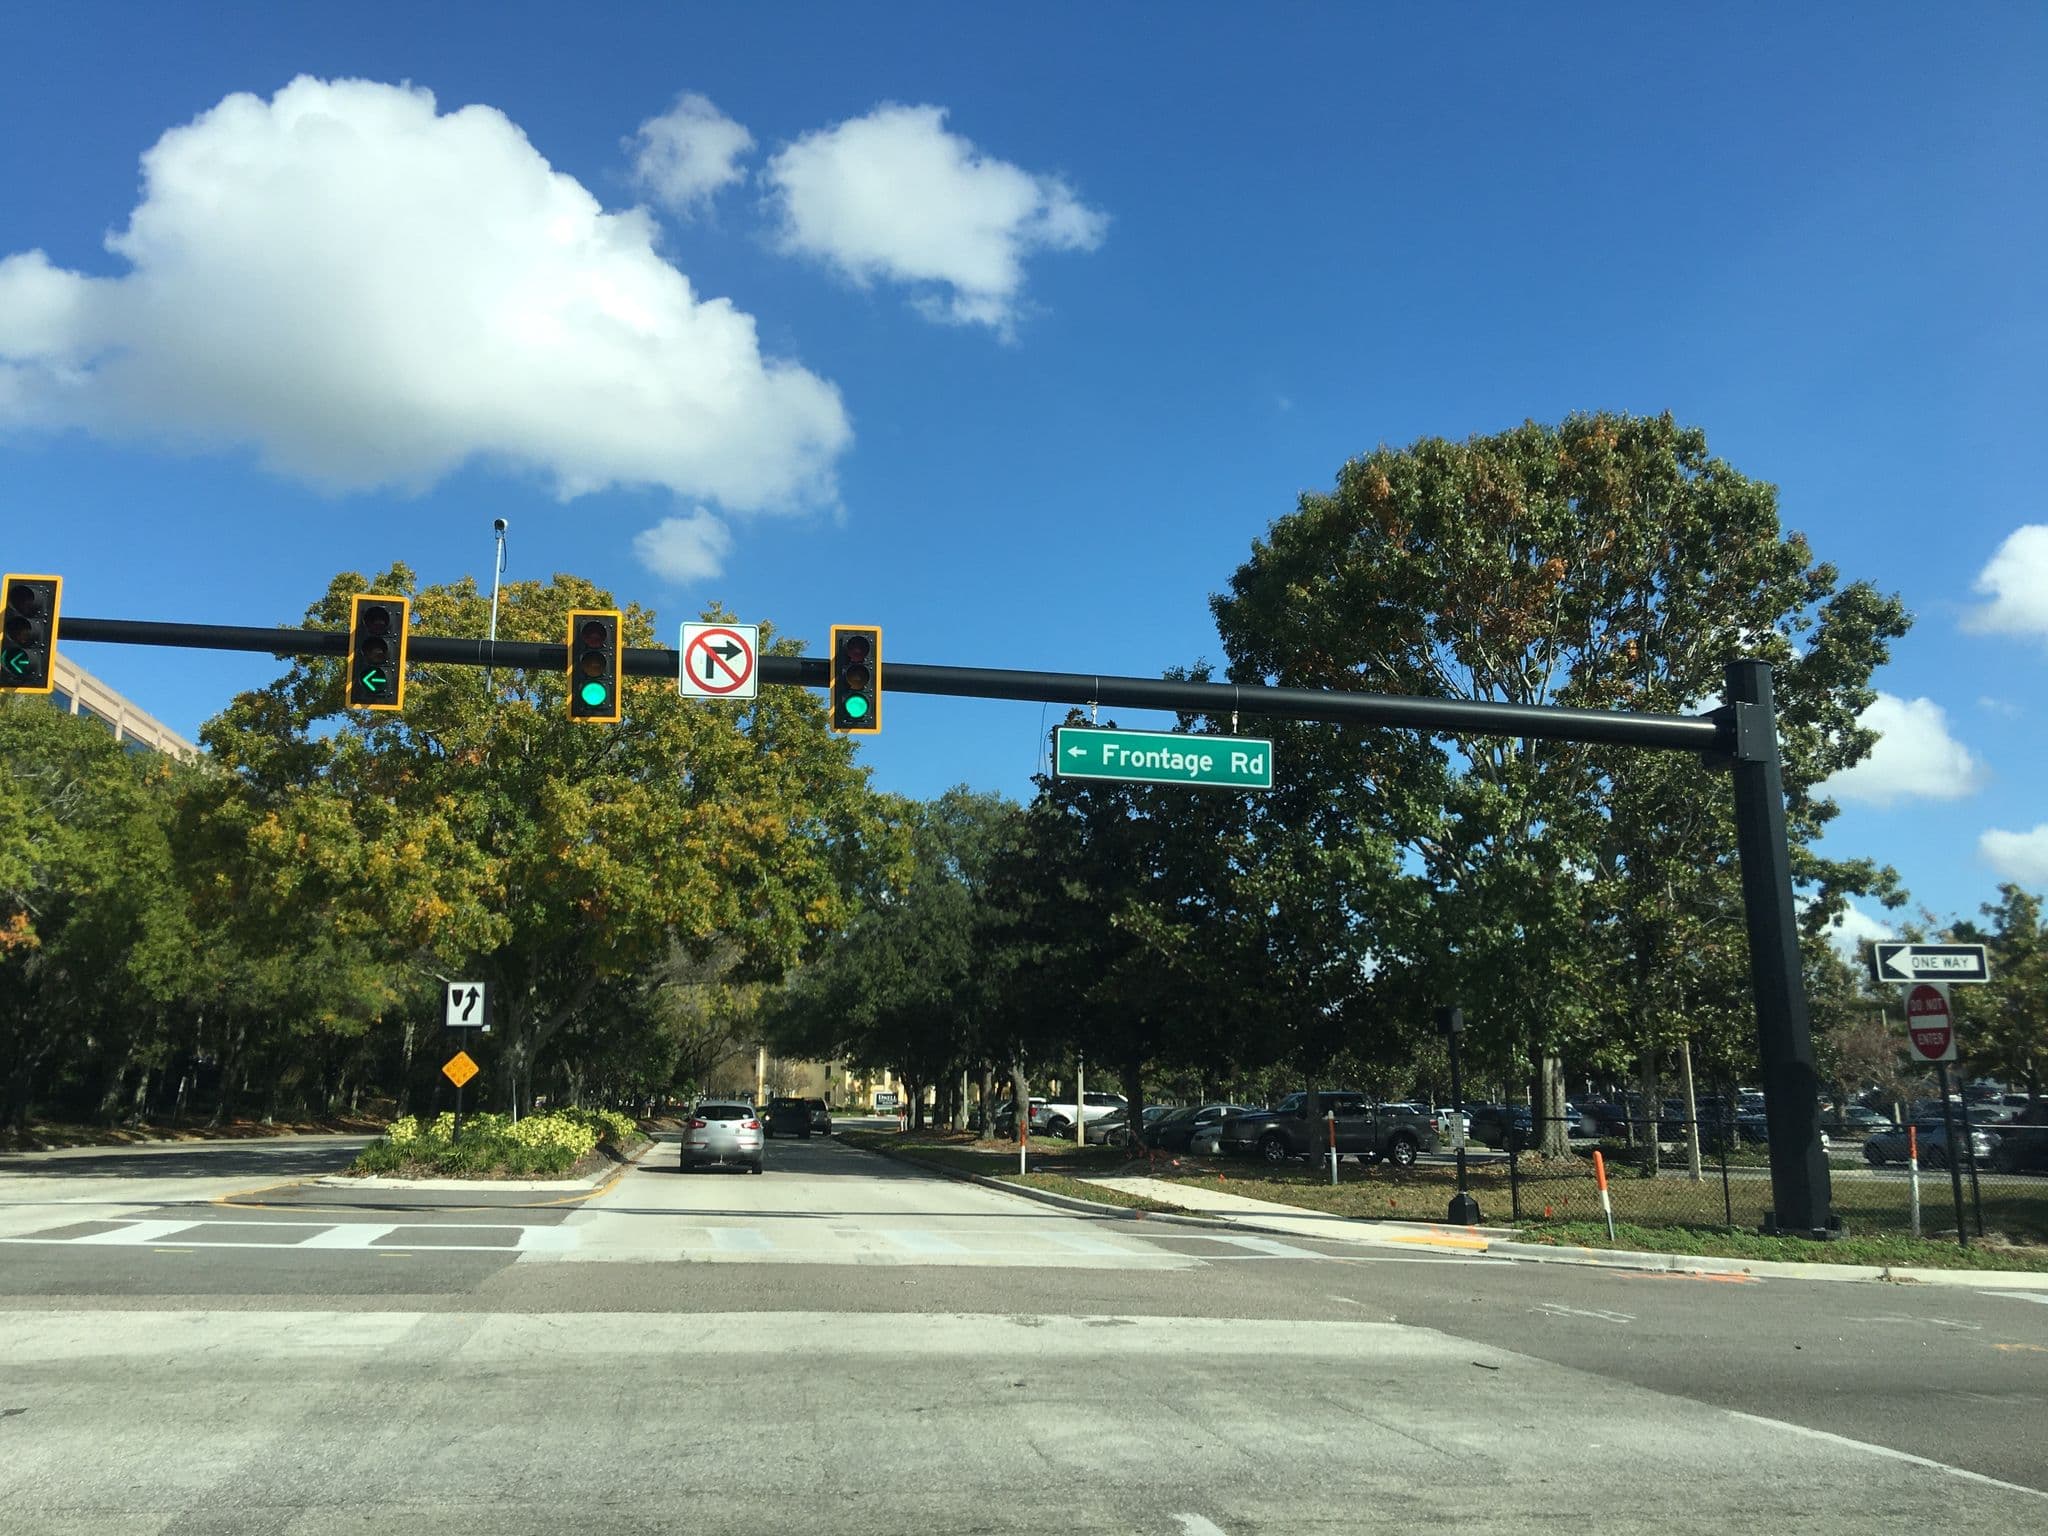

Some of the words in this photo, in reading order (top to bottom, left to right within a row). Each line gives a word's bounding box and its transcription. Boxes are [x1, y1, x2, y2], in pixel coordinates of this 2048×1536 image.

[1102, 743, 1213, 778] Frontage
[1231, 752, 1264, 775] Rd
[1911, 957, 1939, 969] ONE
[1943, 957, 1969, 969] WAY
[1911, 999, 1922, 1011] DO
[1926, 998, 1943, 1010] NOT
[1917, 1032, 1945, 1045] ENTER
